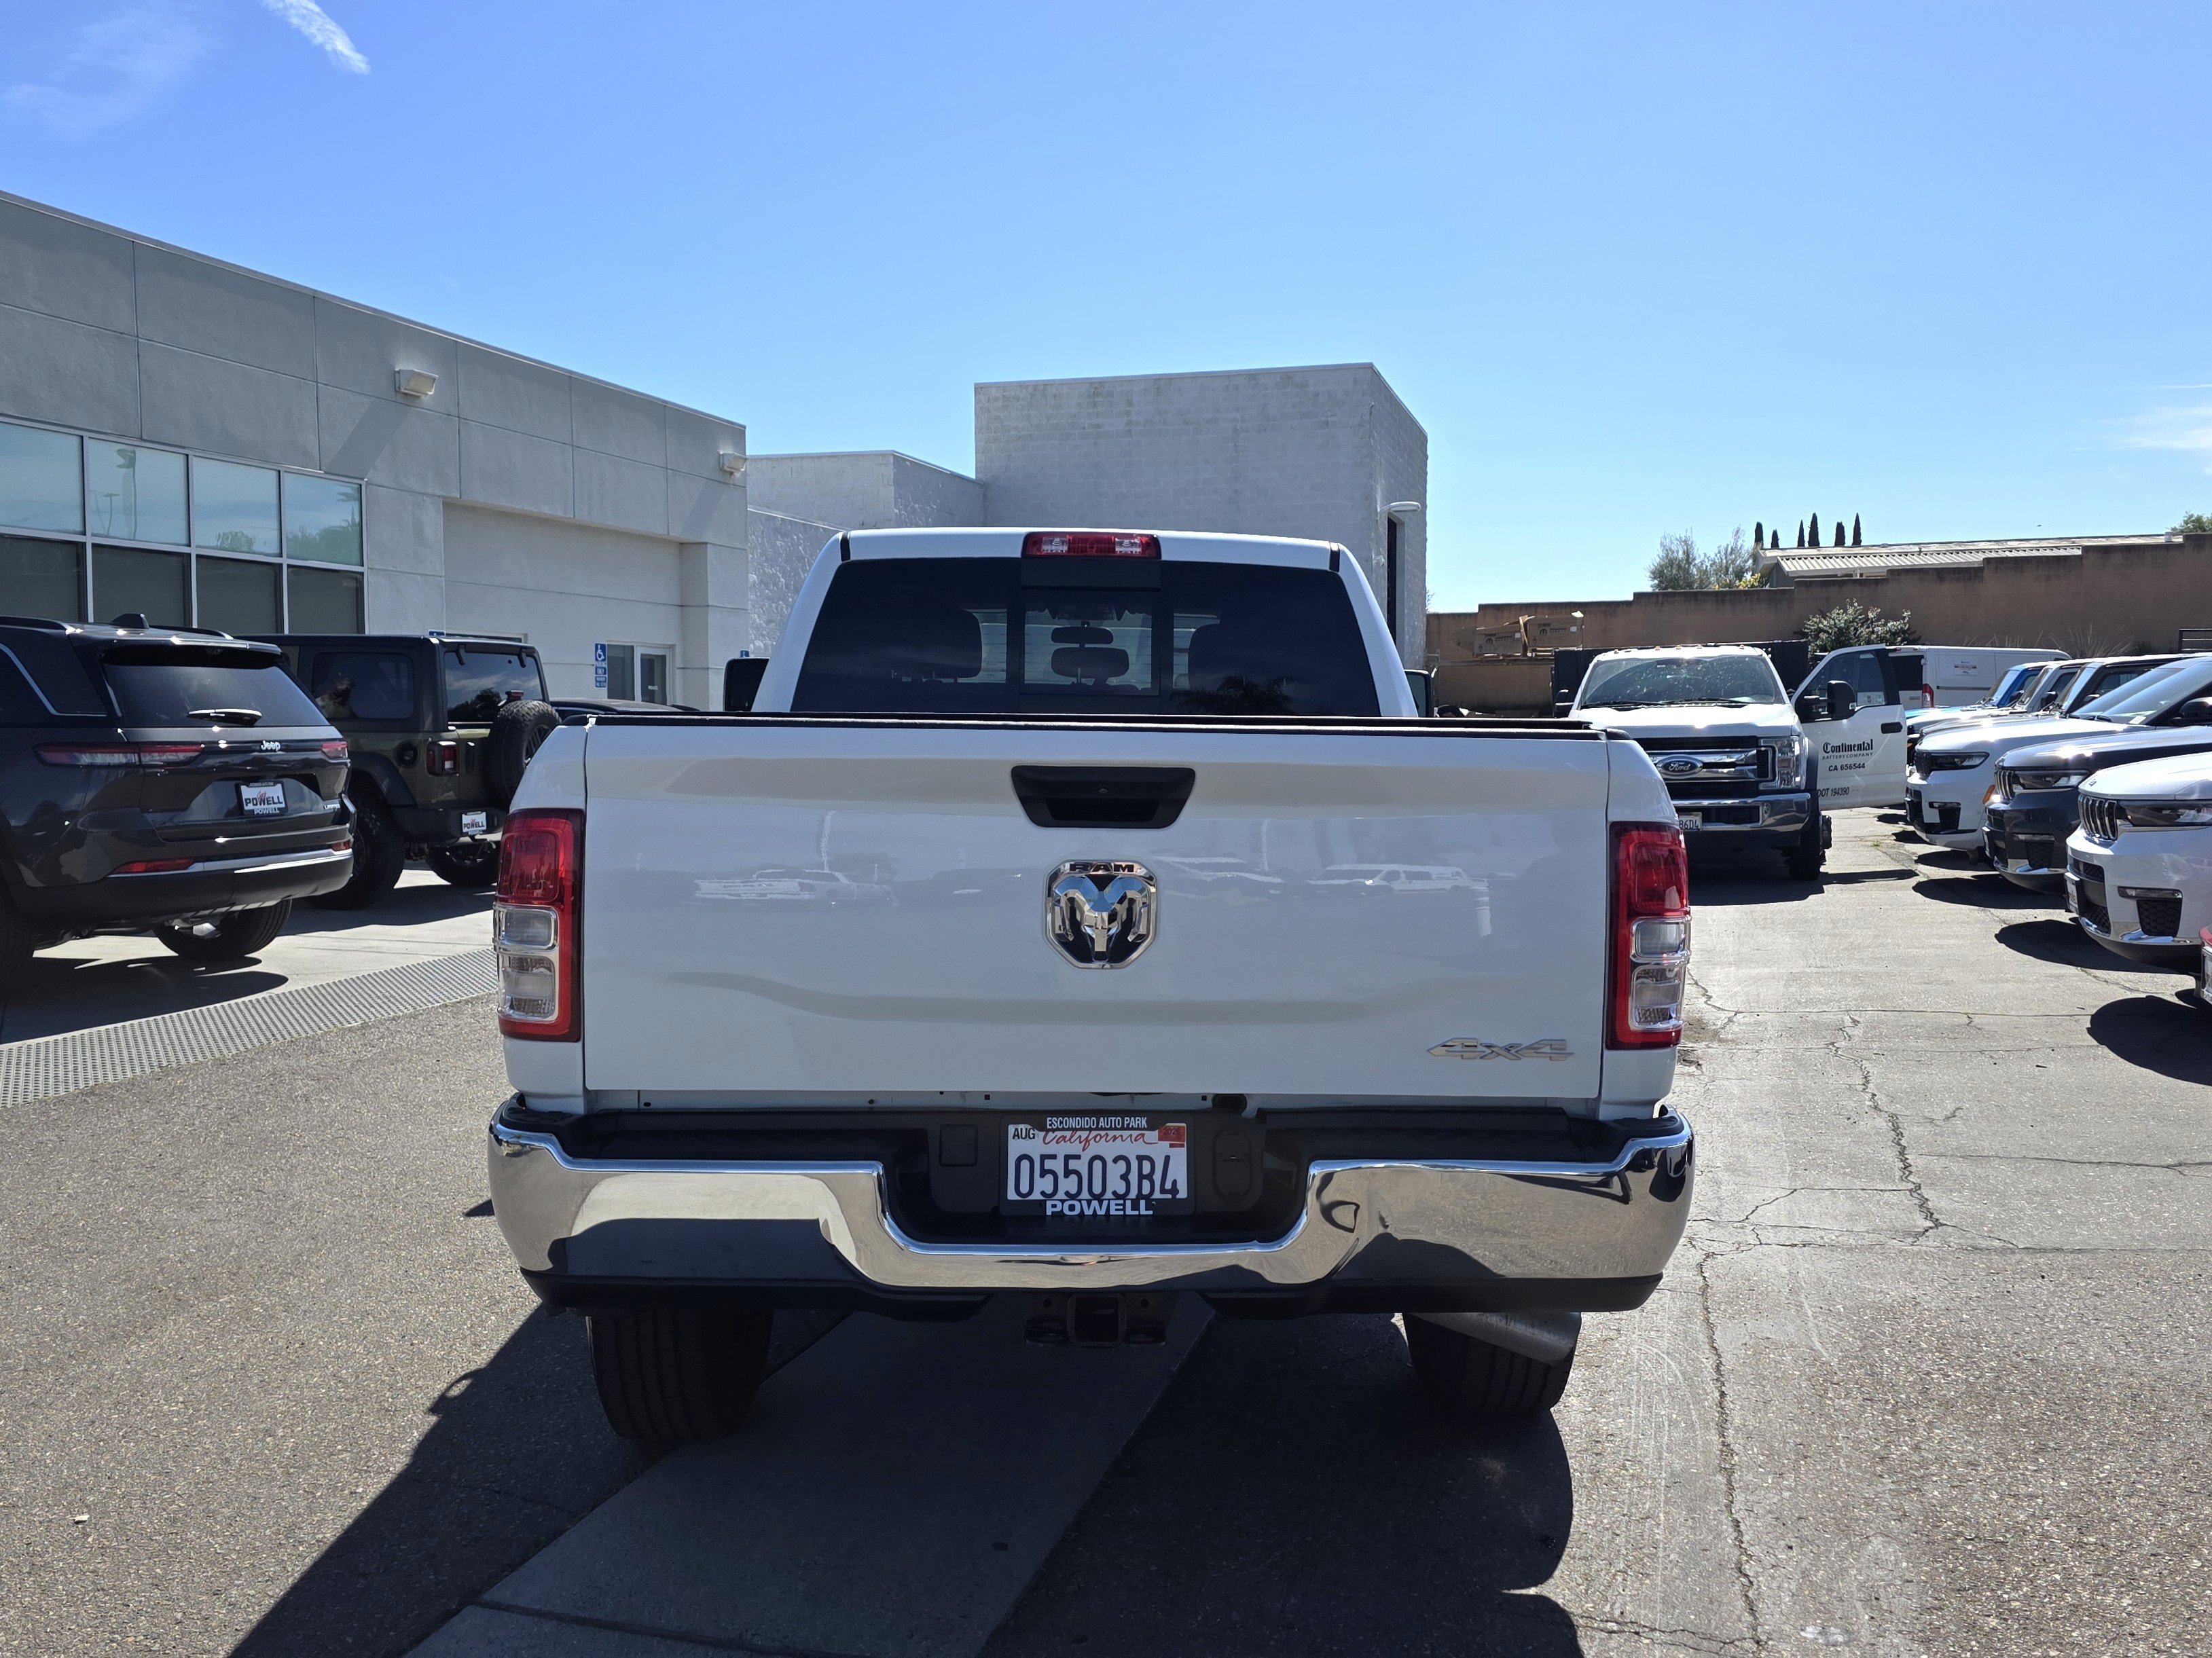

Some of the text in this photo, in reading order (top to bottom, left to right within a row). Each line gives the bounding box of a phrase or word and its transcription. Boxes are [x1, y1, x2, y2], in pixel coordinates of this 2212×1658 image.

[261, 740, 280, 751] Jeep
[1822, 739, 1873, 754] Continental
[1668, 762, 1691, 771] Ford
[1840, 762, 1866, 771] 656544
[1830, 787, 1850, 797] 194390
[244, 795, 283, 807] POWELL
[1069, 863, 1134, 873] RAM
[1047, 1117, 1148, 1128] ESCONDIDO AUTO PARK
[1012, 1128, 1036, 1139] AUG
[1042, 1130, 1159, 1152] California
[1014, 1154, 1180, 1198] 05503B4
[1046, 1199, 1153, 1215] POWELL
